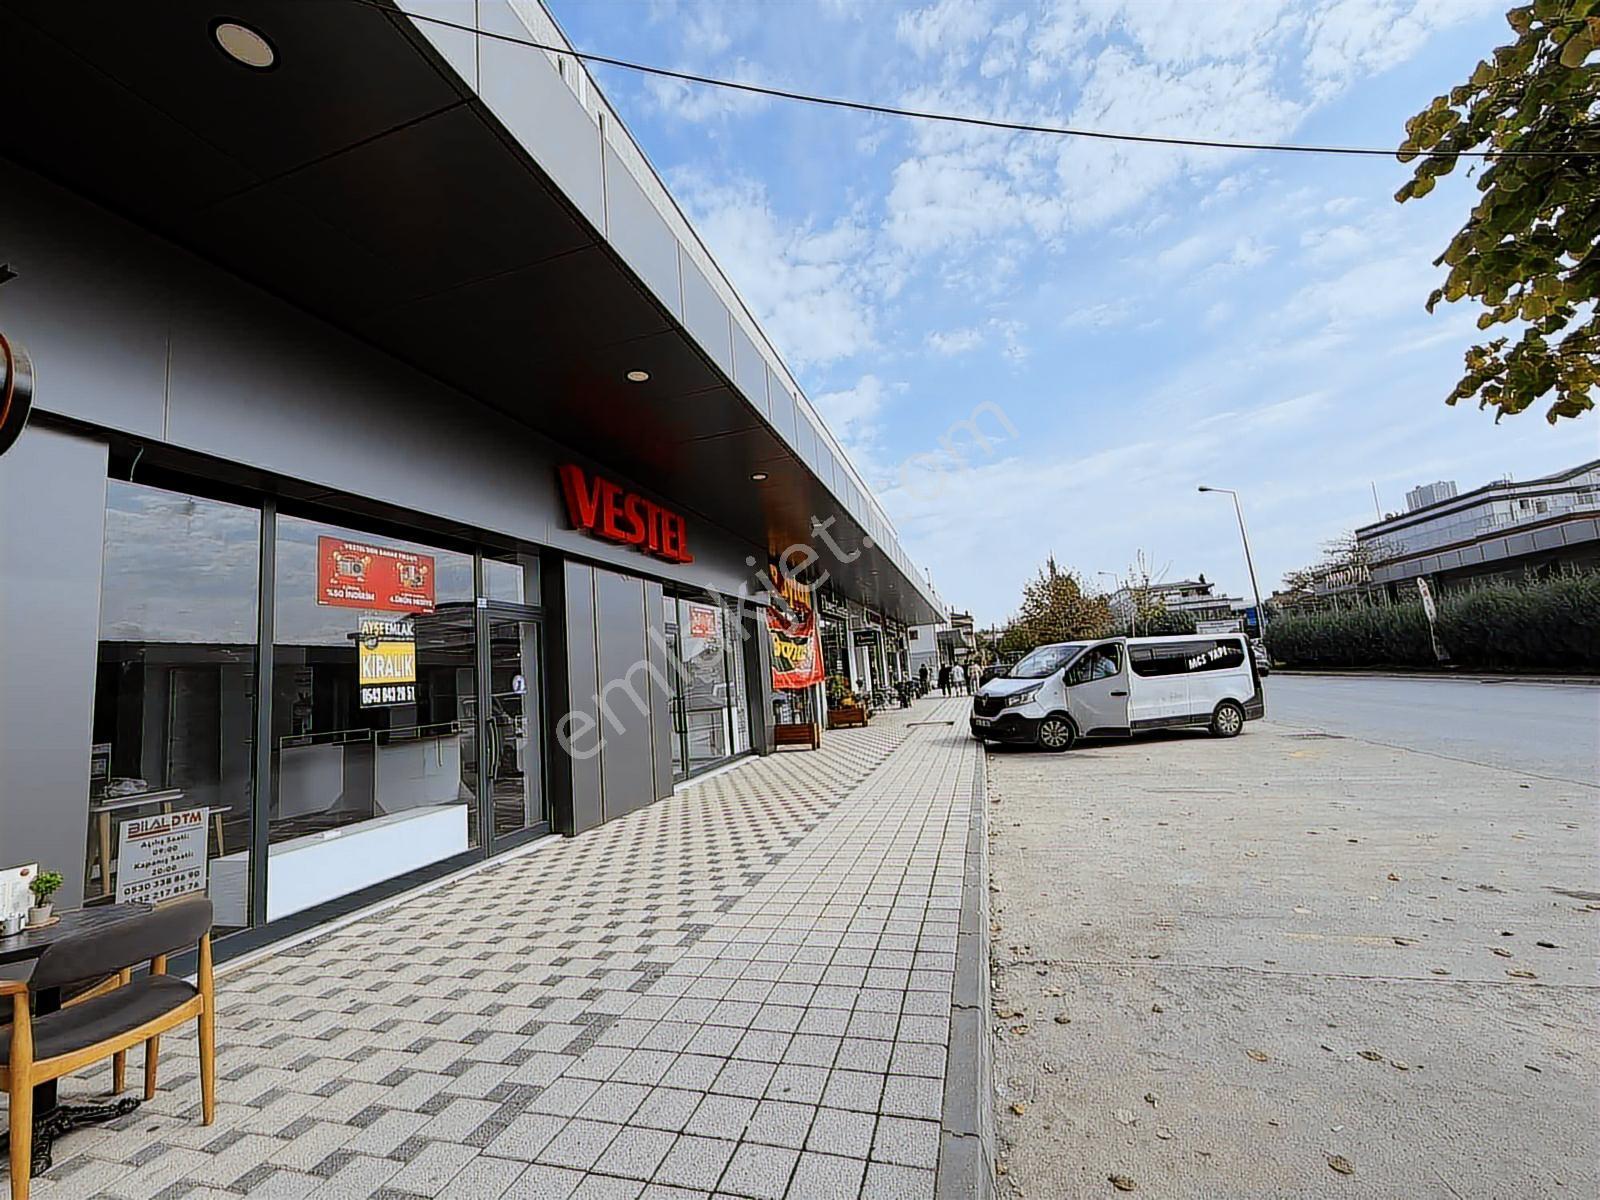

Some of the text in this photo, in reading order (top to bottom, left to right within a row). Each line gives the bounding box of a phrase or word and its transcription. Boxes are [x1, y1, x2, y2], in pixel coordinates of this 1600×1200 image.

[558, 463, 695, 564] VESTEL
[1188, 653, 1207, 671] MCS
[171, 811, 202, 826] DTM
[151, 864, 178, 876] 20:00
[123, 883, 151, 896] 0530
